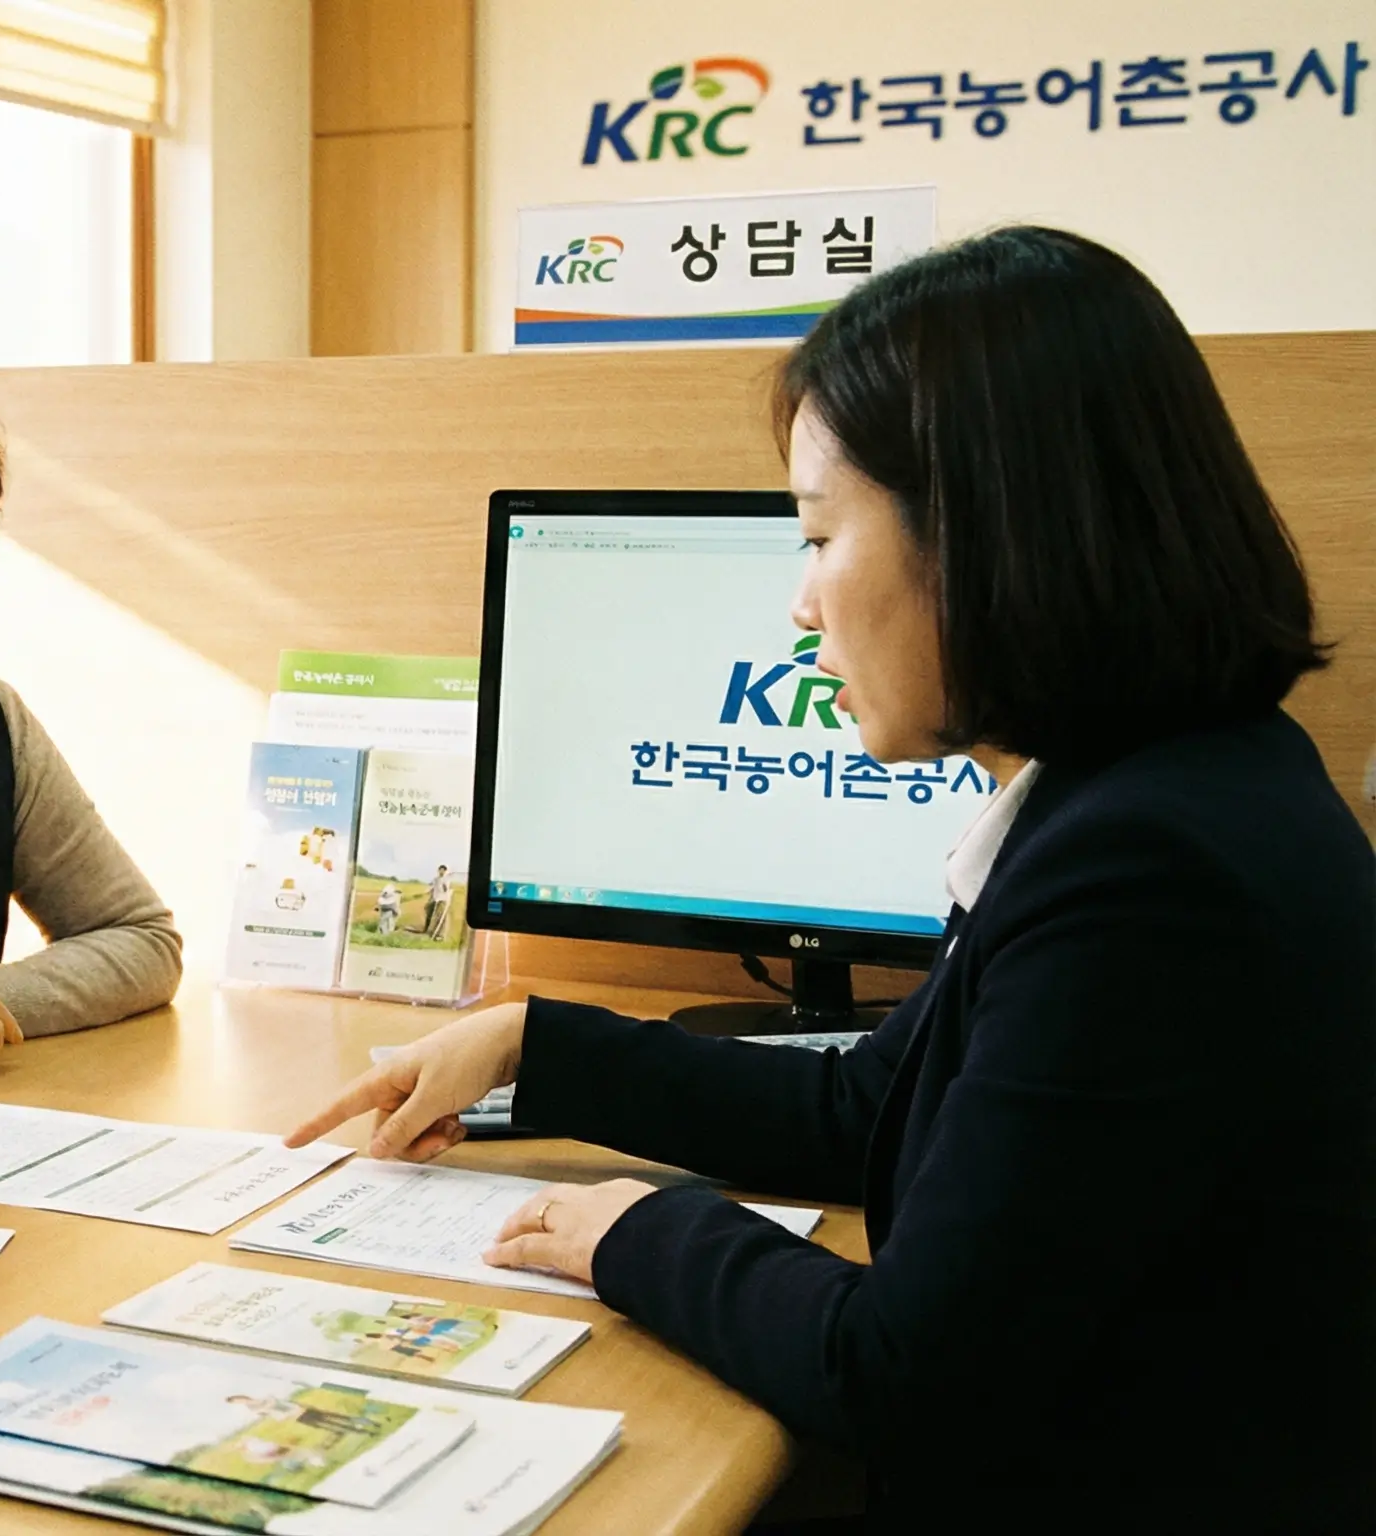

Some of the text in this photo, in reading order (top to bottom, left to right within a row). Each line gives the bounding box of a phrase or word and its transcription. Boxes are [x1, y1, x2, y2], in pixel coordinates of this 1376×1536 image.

[582, 41, 1370, 165] KRC 한국농어촌공사
[535, 216, 875, 285] KRC 상담실
[719, 660, 860, 730] KR
[805, 937, 820, 948] LG
